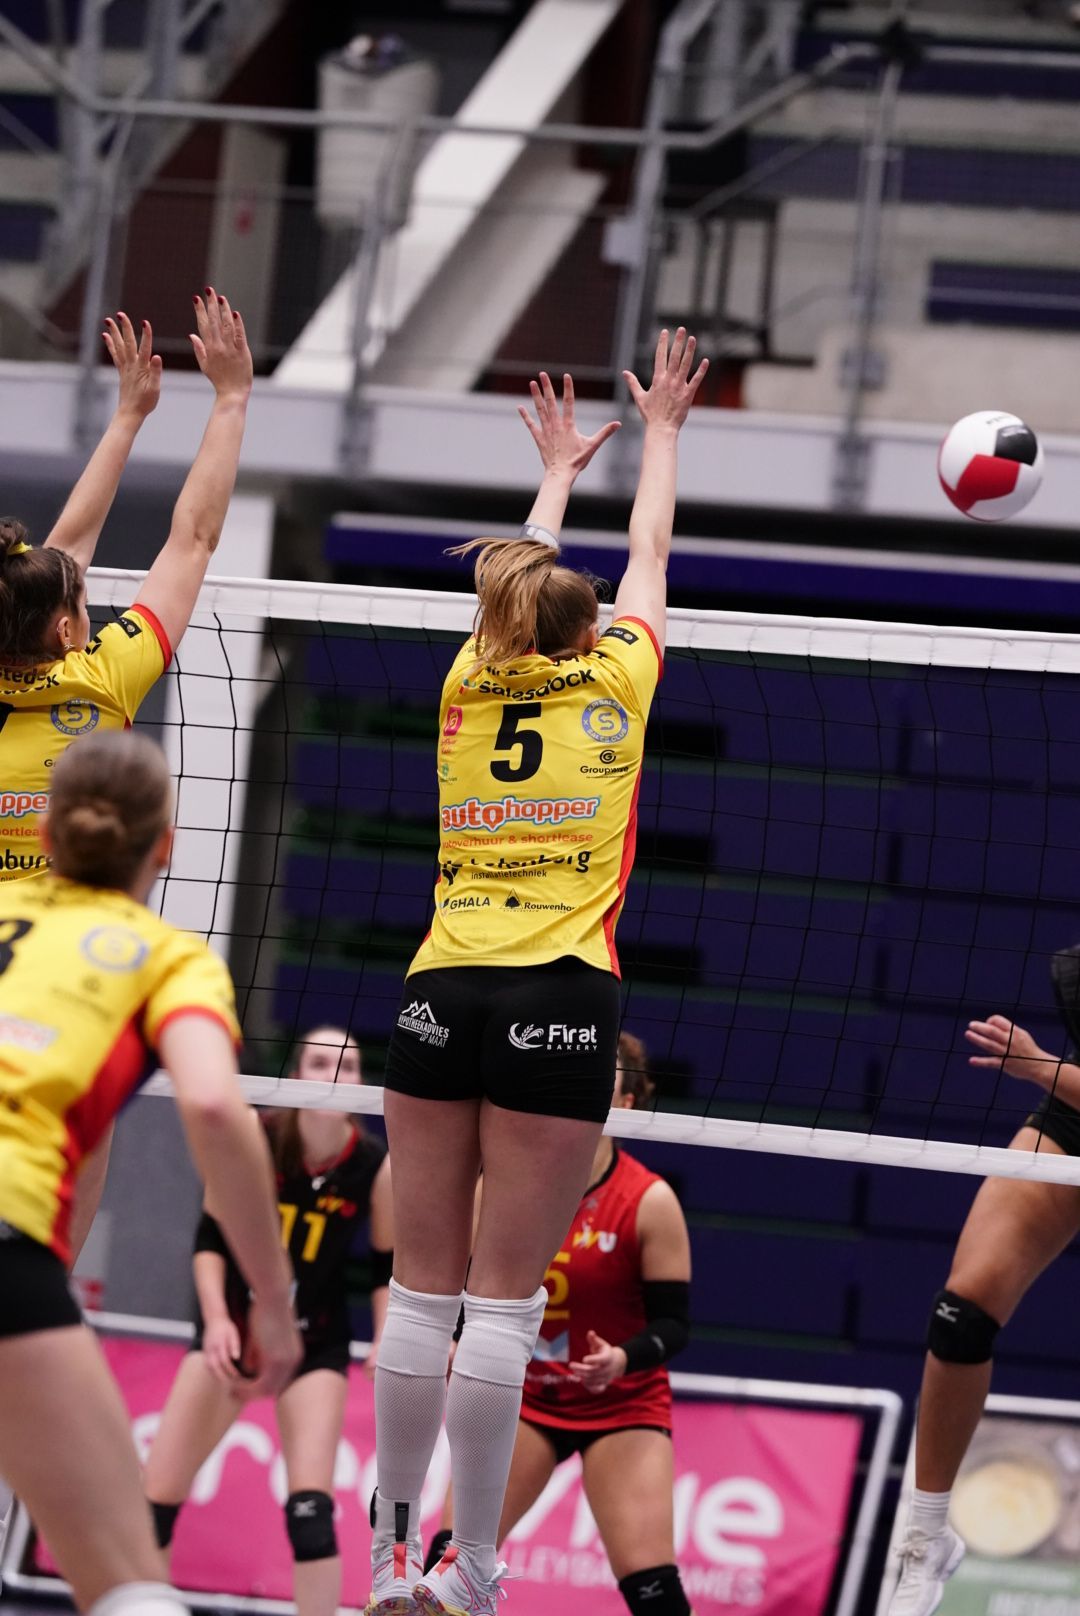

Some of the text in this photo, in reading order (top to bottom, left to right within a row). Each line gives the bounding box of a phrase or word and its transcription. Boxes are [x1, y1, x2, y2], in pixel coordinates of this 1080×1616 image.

[490, 702, 543, 783] 5
[508, 835, 517, 844] &
[521, 833, 593, 844] shortlease
[471, 868, 547, 880] installatietechniek
[450, 897, 490, 909] GHALA
[524, 902, 576, 912] Rouwenho
[428, 1034, 448, 1048] MAAT
